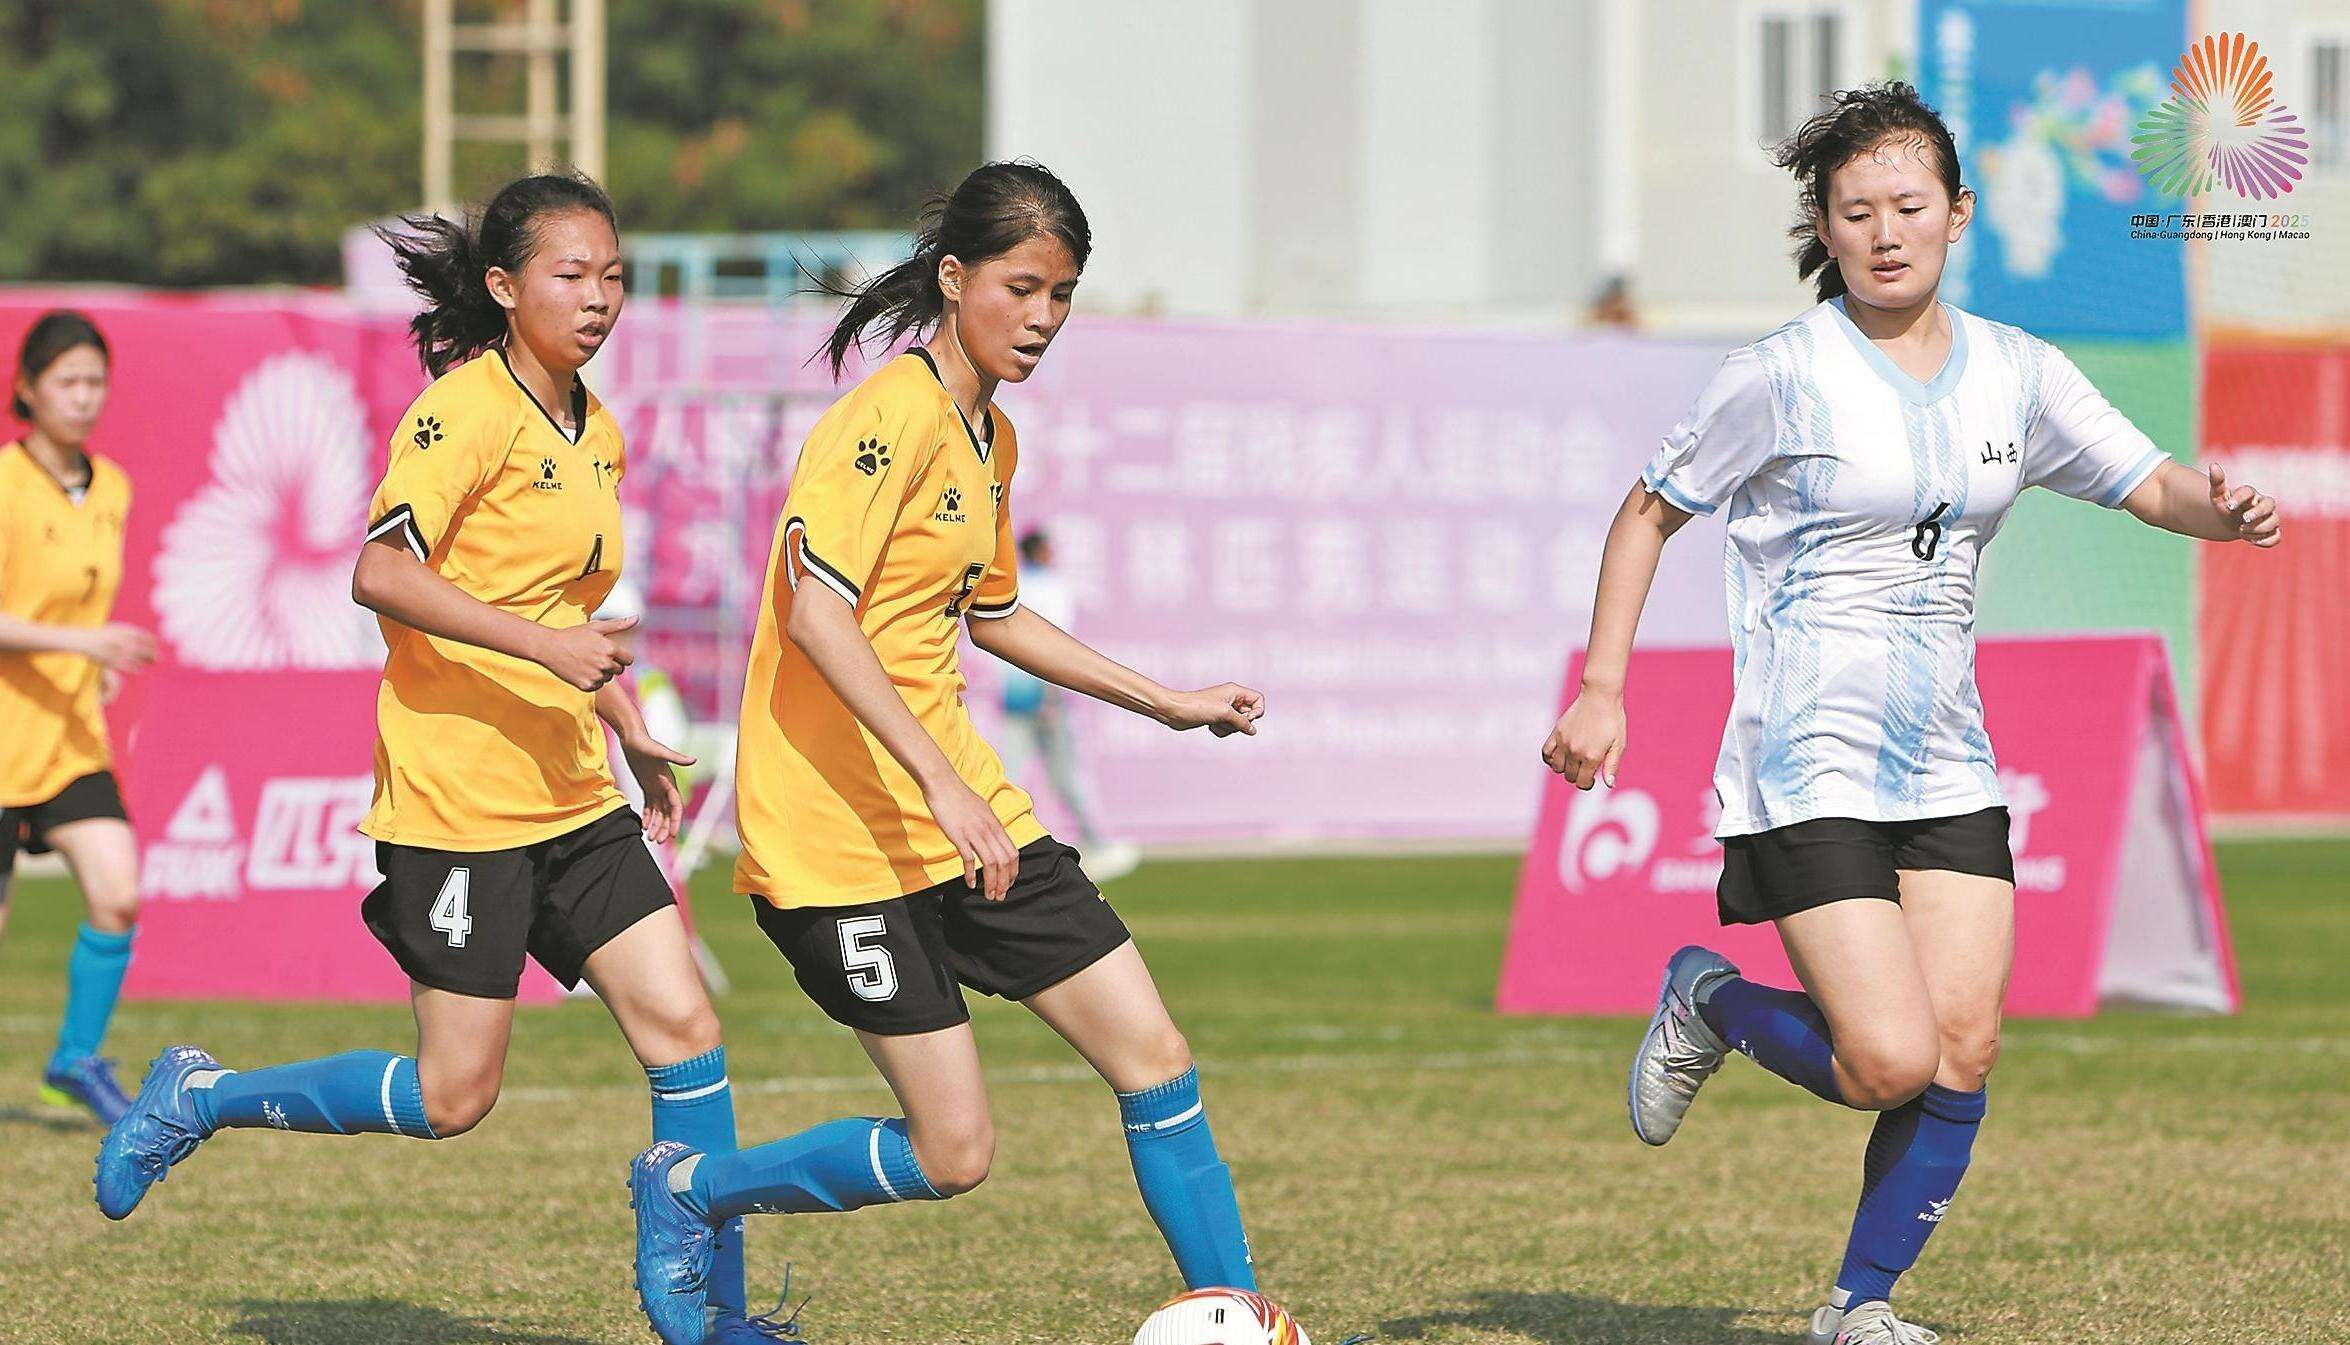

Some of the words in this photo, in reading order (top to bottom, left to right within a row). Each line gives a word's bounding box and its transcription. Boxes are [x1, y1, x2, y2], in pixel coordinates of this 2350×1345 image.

[532, 481, 563, 490] KELME
[934, 512, 966, 523] KELME
[1911, 502, 1951, 562] 6
[429, 866, 472, 948] 4
[836, 913, 900, 1002] 5
